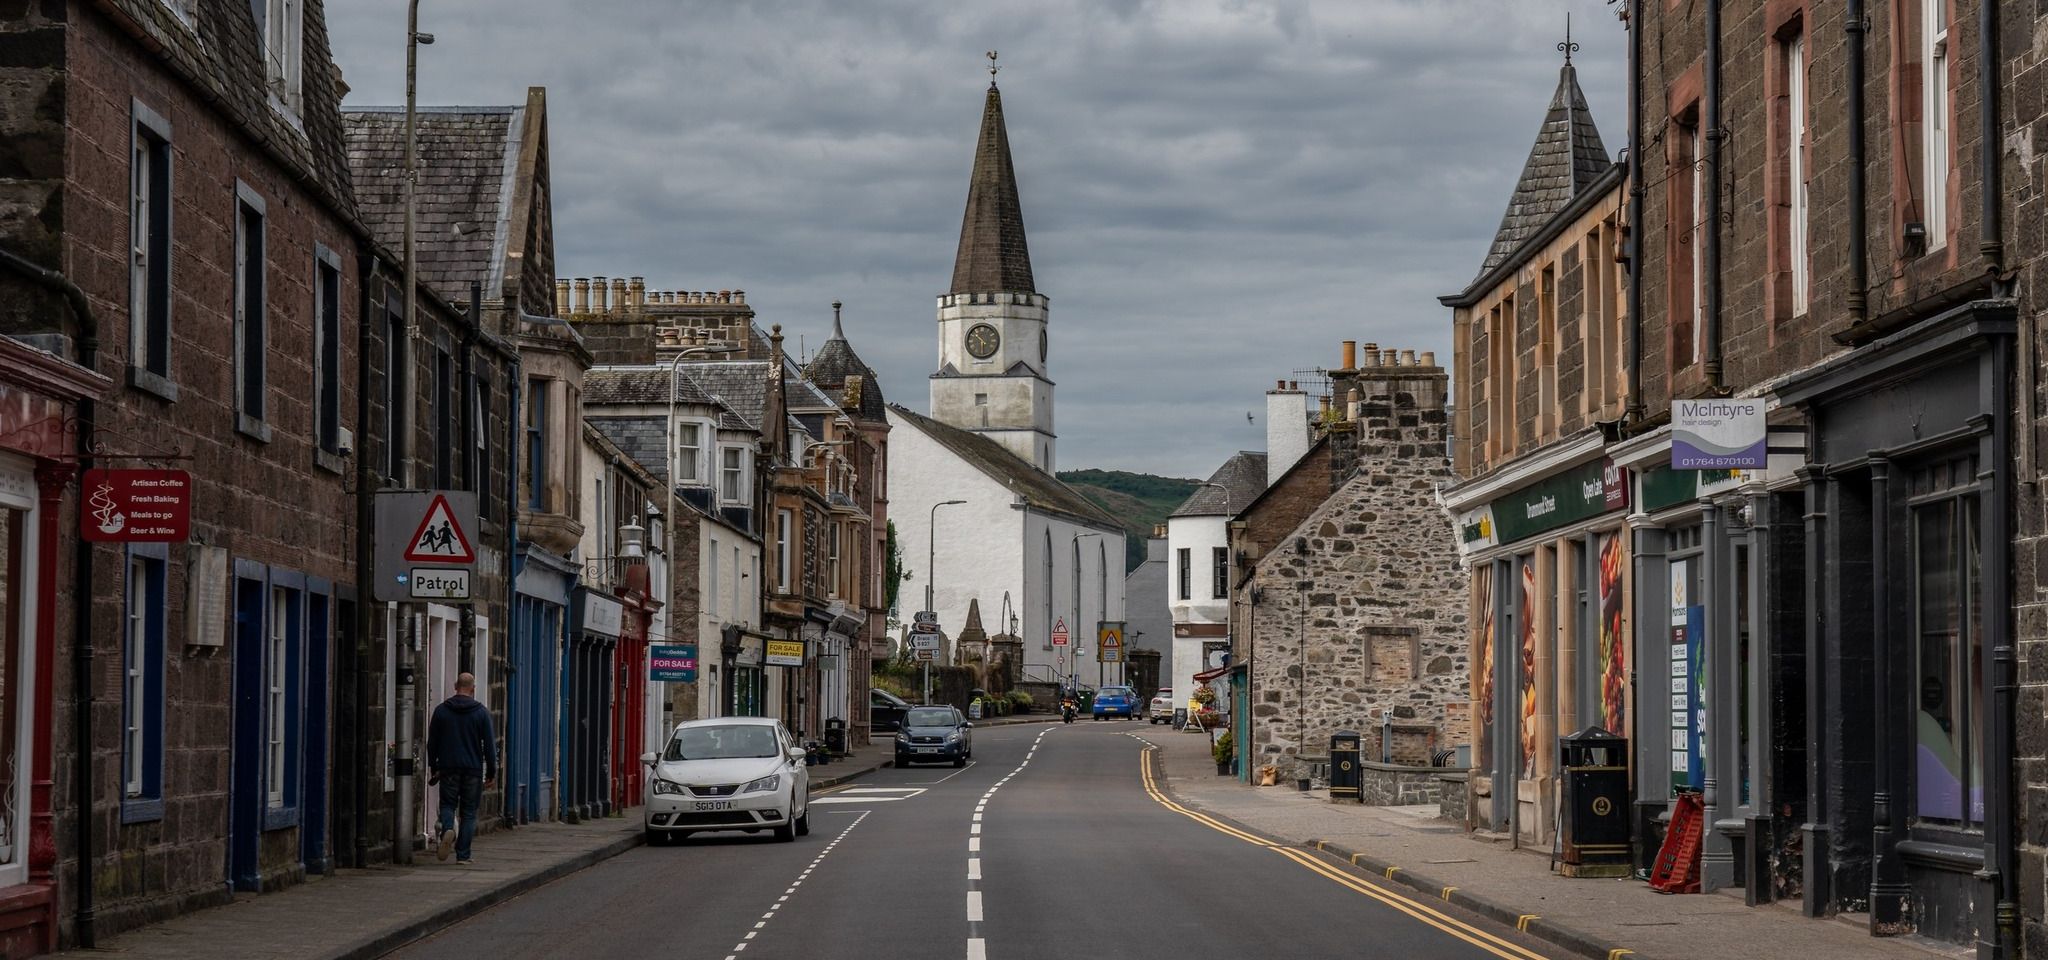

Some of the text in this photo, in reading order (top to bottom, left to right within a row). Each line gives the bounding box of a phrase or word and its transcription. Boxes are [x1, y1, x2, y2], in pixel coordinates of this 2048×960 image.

[1682, 402, 1755, 420] McIntyre
[1697, 419, 1722, 427] design
[1682, 457, 1755, 466] 01764 670100
[1583, 478, 1603, 505] Open Late
[153, 496, 180, 504] Baking
[416, 576, 464, 590] Patrol
[783, 645, 801, 653] SALE
[671, 660, 692, 668] SALE
[695, 801, 733, 811] SG13 OTA
